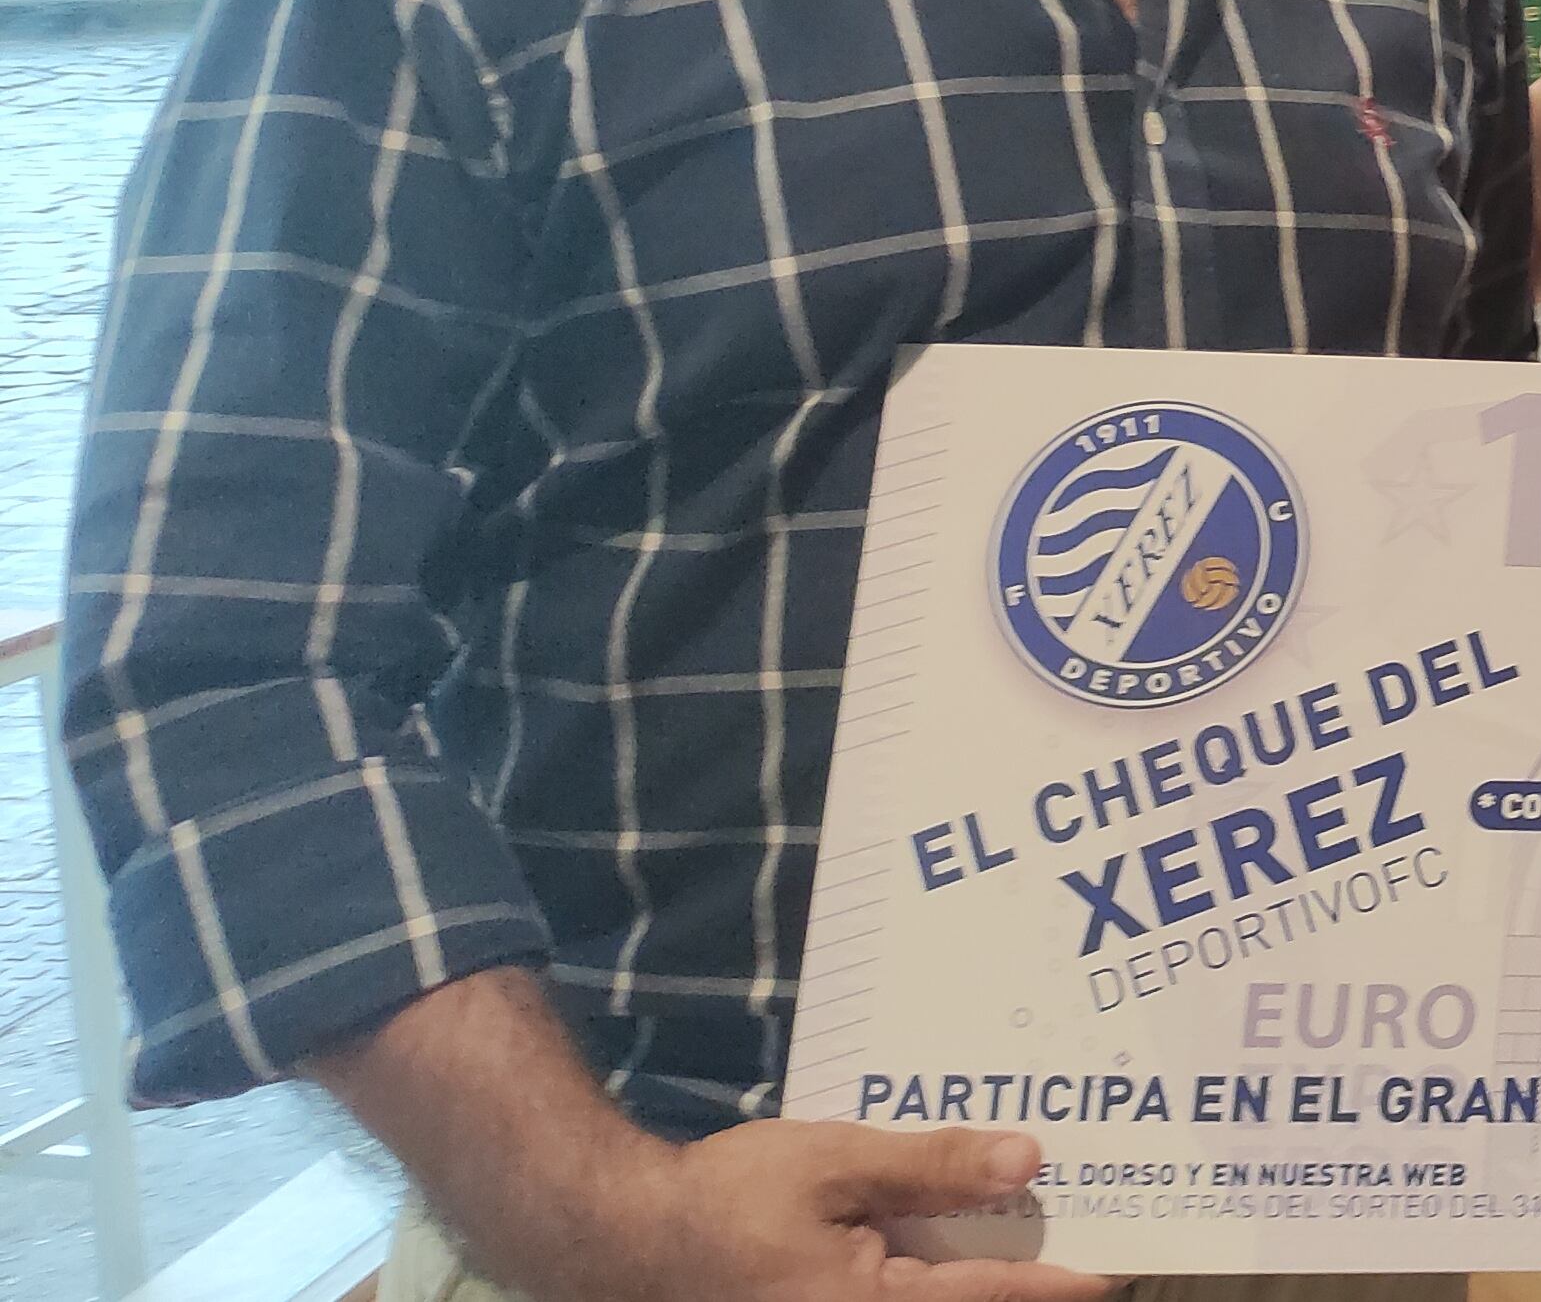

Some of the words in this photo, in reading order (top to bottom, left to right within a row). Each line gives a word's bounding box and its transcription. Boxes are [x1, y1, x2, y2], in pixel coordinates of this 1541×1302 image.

[1075, 414, 1160, 453] 1911
[1268, 500, 1293, 521] C
[1005, 584, 1026, 606] F
[1060, 593, 1283, 694] DEPORTIVO
[911, 812, 1017, 891] EL
[1034, 682, 1353, 845] CHEQUE
[1366, 630, 1520, 726] DEL
[1057, 751, 1428, 960] XEREZ
[1088, 846, 1449, 1014] DEPORTIVOFC
[1243, 982, 1477, 1049] EURO
[857, 1074, 1170, 1123] PARTICIPA
[1191, 1075, 1272, 1124] EN
[1289, 1075, 1362, 1124] EL
[1378, 1075, 1541, 1125] GRAN
[1035, 1163, 1073, 1187] EL
[1078, 1163, 1177, 1188] DORSO
[1184, 1163, 1202, 1188] Y
[1211, 1163, 1250, 1188] EN
[1259, 1163, 1394, 1188] NUESTRA
[1403, 1163, 1467, 1187] WEB
[1150, 1195, 1258, 1220] CIFRAS
[1264, 1195, 1321, 1221] DEL
[1328, 1195, 1441, 1221] SORTEO
[1450, 1195, 1504, 1221] DEL
